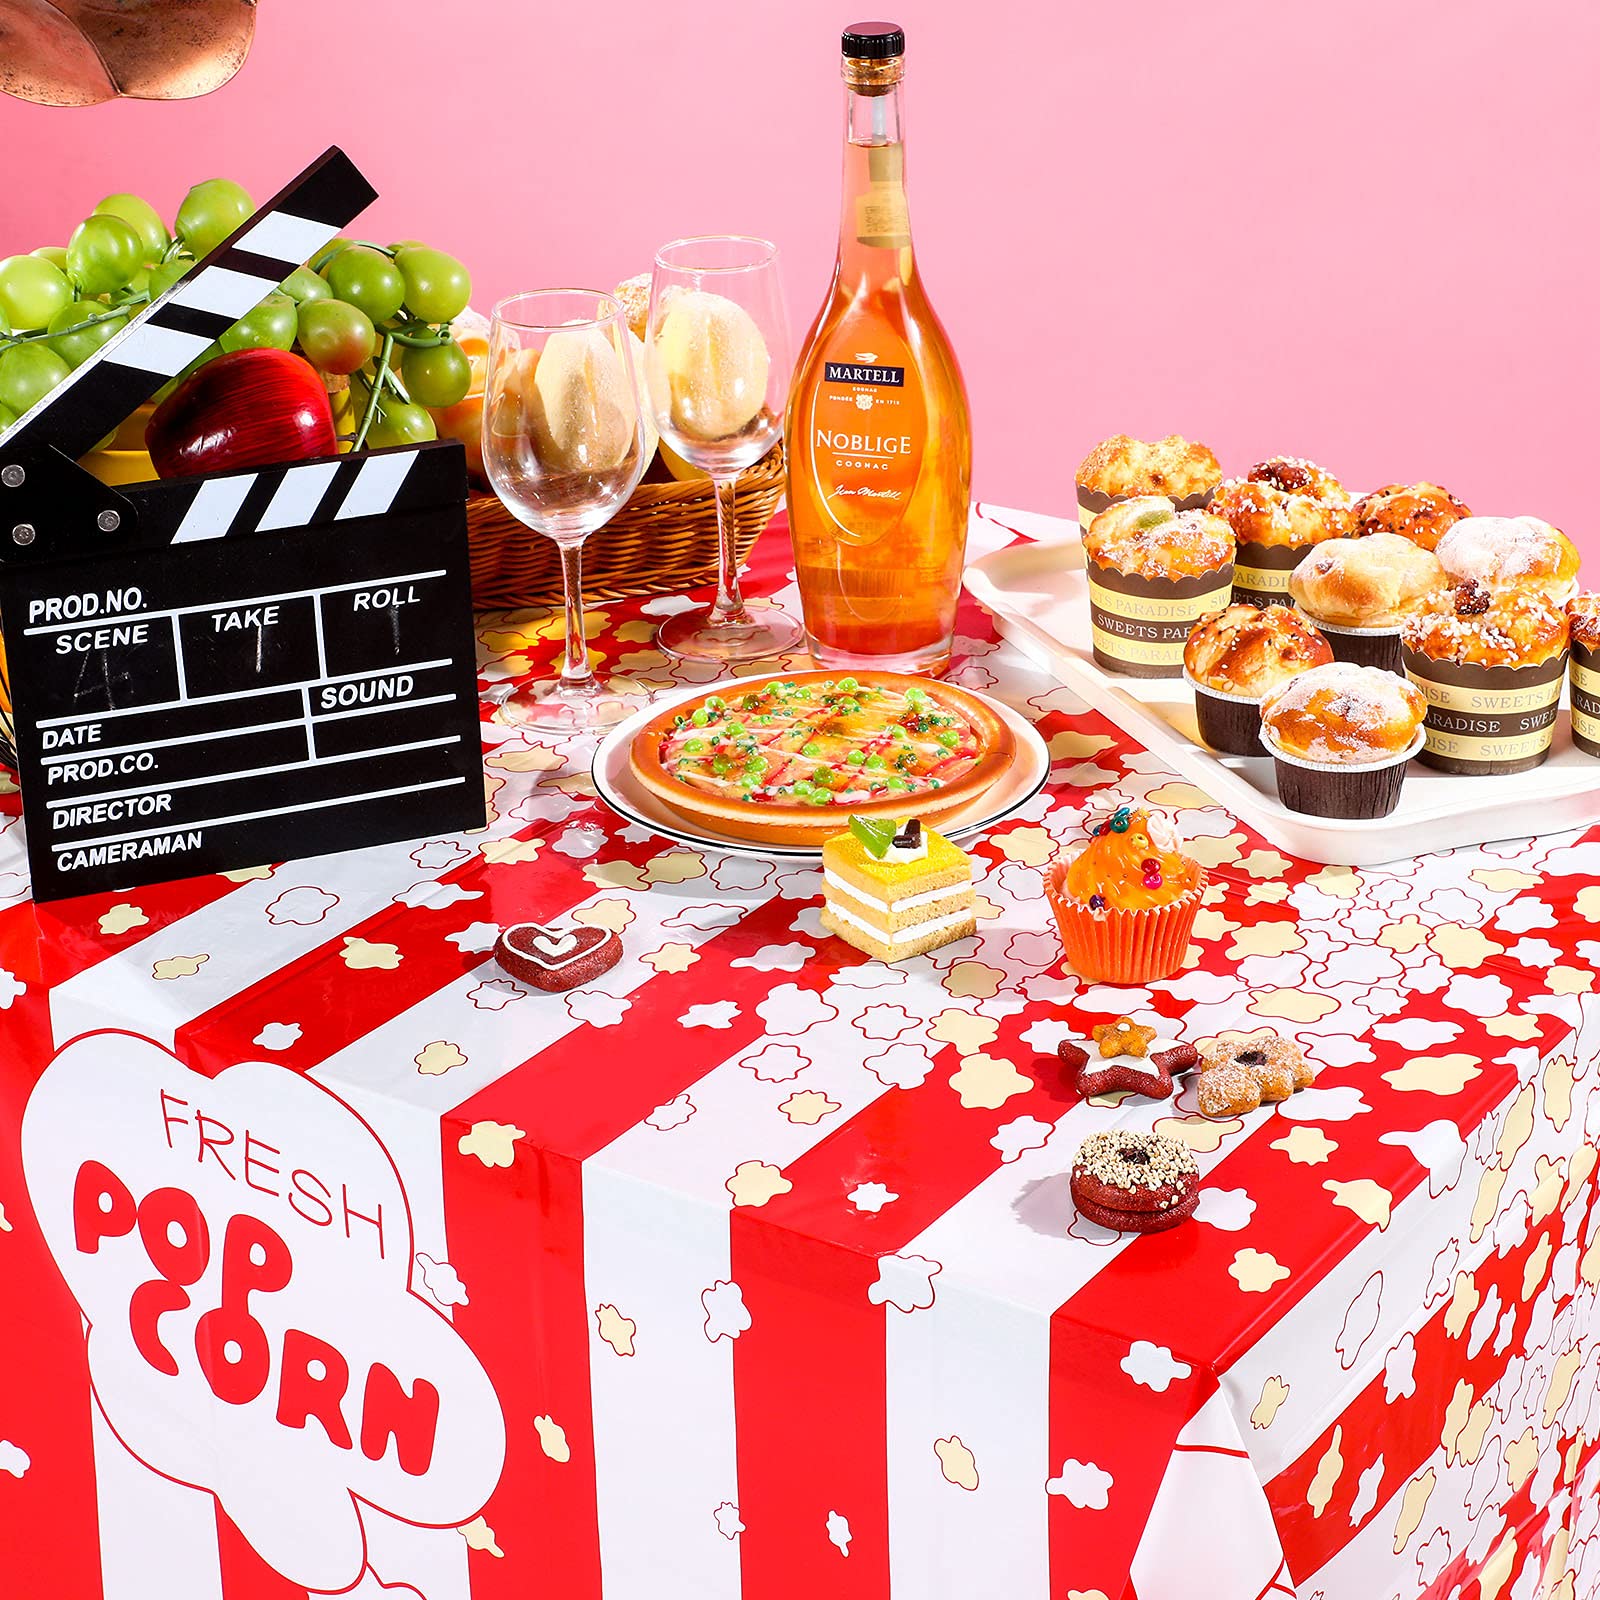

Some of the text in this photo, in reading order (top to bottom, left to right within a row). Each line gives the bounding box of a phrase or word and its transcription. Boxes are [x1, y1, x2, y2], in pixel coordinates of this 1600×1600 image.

[829, 366, 900, 384] MARTELL
[816, 429, 911, 454] NOBLIGE
[836, 459, 888, 471] COGNAC
[353, 586, 421, 612] ROLL
[1116, 599, 1197, 617] PARADISE
[211, 606, 280, 633] TAKE
[1097, 613, 1158, 638] SWEETS
[55, 624, 150, 655] SCENE
[320, 675, 414, 710] SOUND
[1472, 690, 1543, 708] SWEETS
[42, 724, 102, 750] DATE
[1480, 735, 1546, 756] SWEETS
[47, 752, 159, 786] PROD.CO.
[52, 793, 172, 829] DIRECTOR
[57, 831, 202, 872] CAMERAMAN
[160, 1088, 385, 1259] FRESH
[73, 1160, 292, 1312] POP
[129, 1279, 440, 1476] CORN
